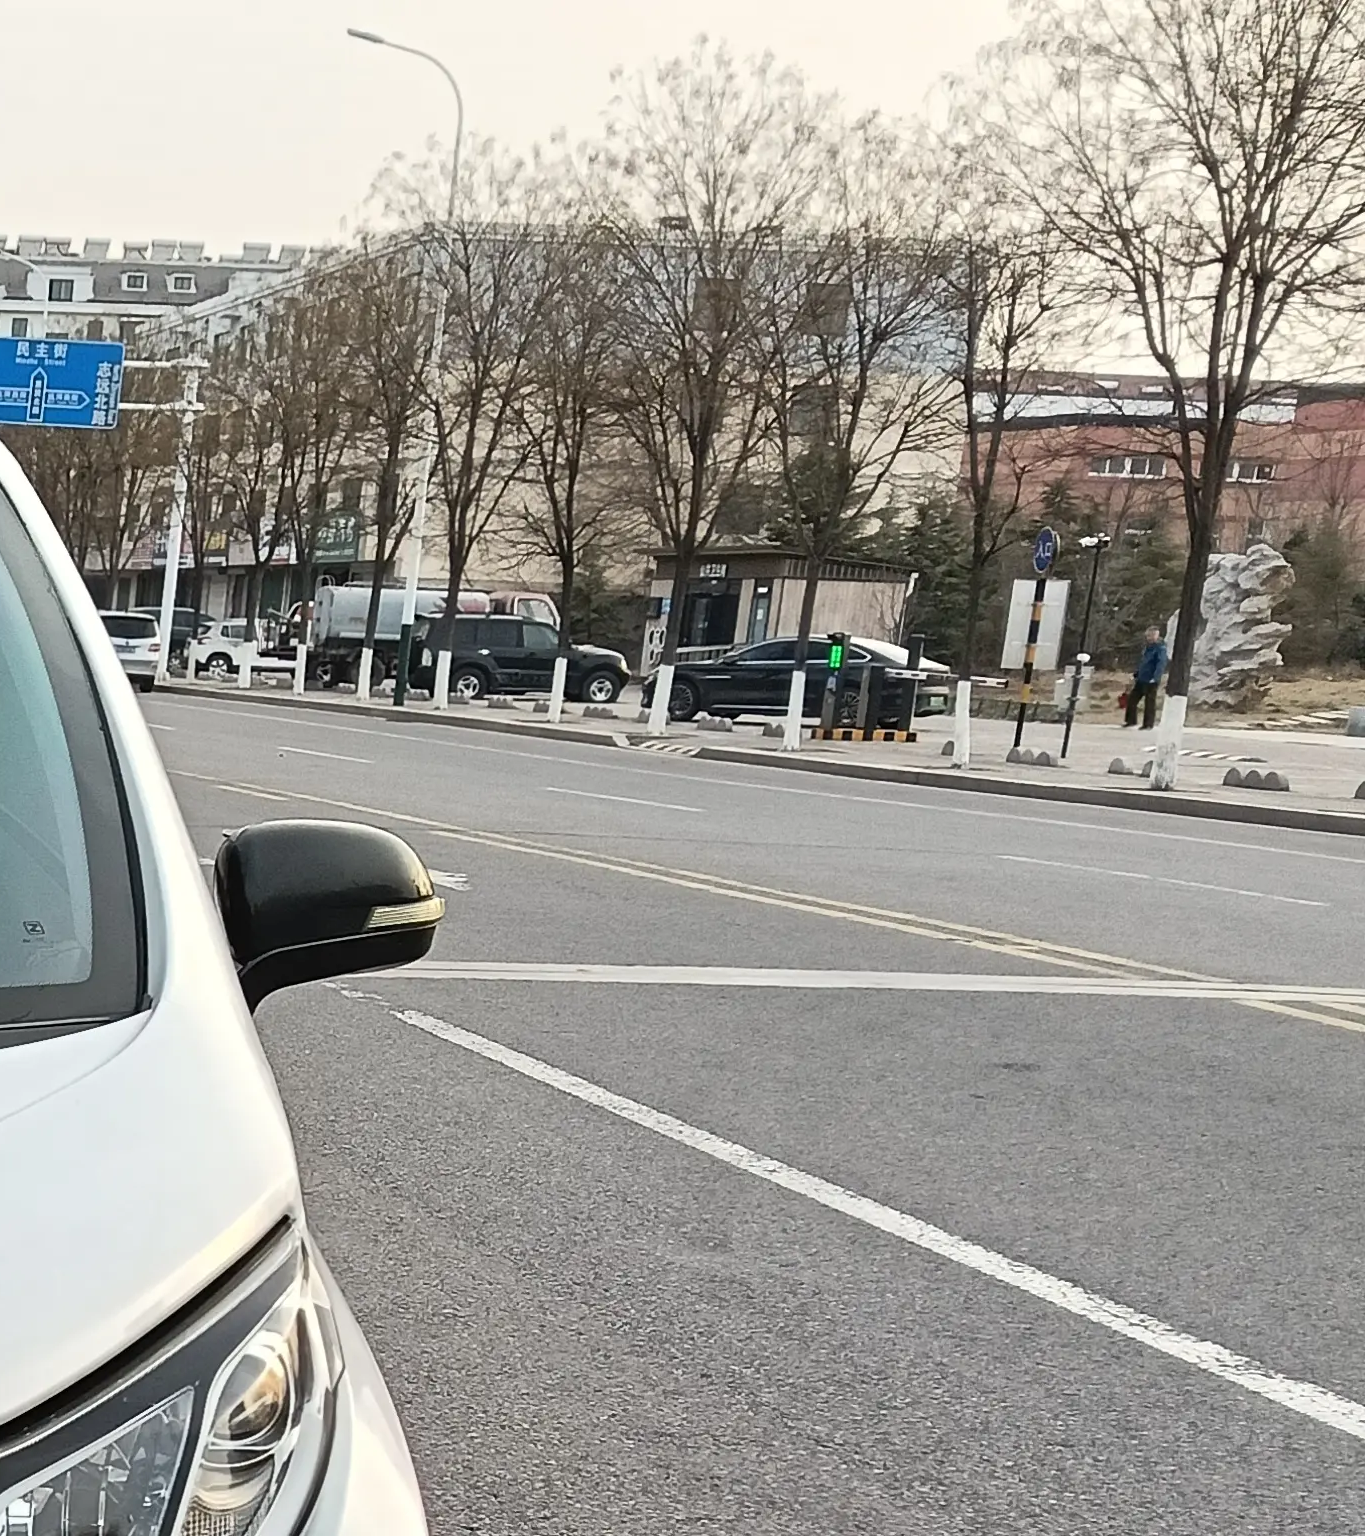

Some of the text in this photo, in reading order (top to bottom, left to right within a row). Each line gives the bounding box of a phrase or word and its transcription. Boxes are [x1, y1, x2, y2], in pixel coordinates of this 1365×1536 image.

[16, 342, 68, 358] 民主街
[91, 362, 112, 427] 志远北路
[1035, 541, 1053, 558] 入口
